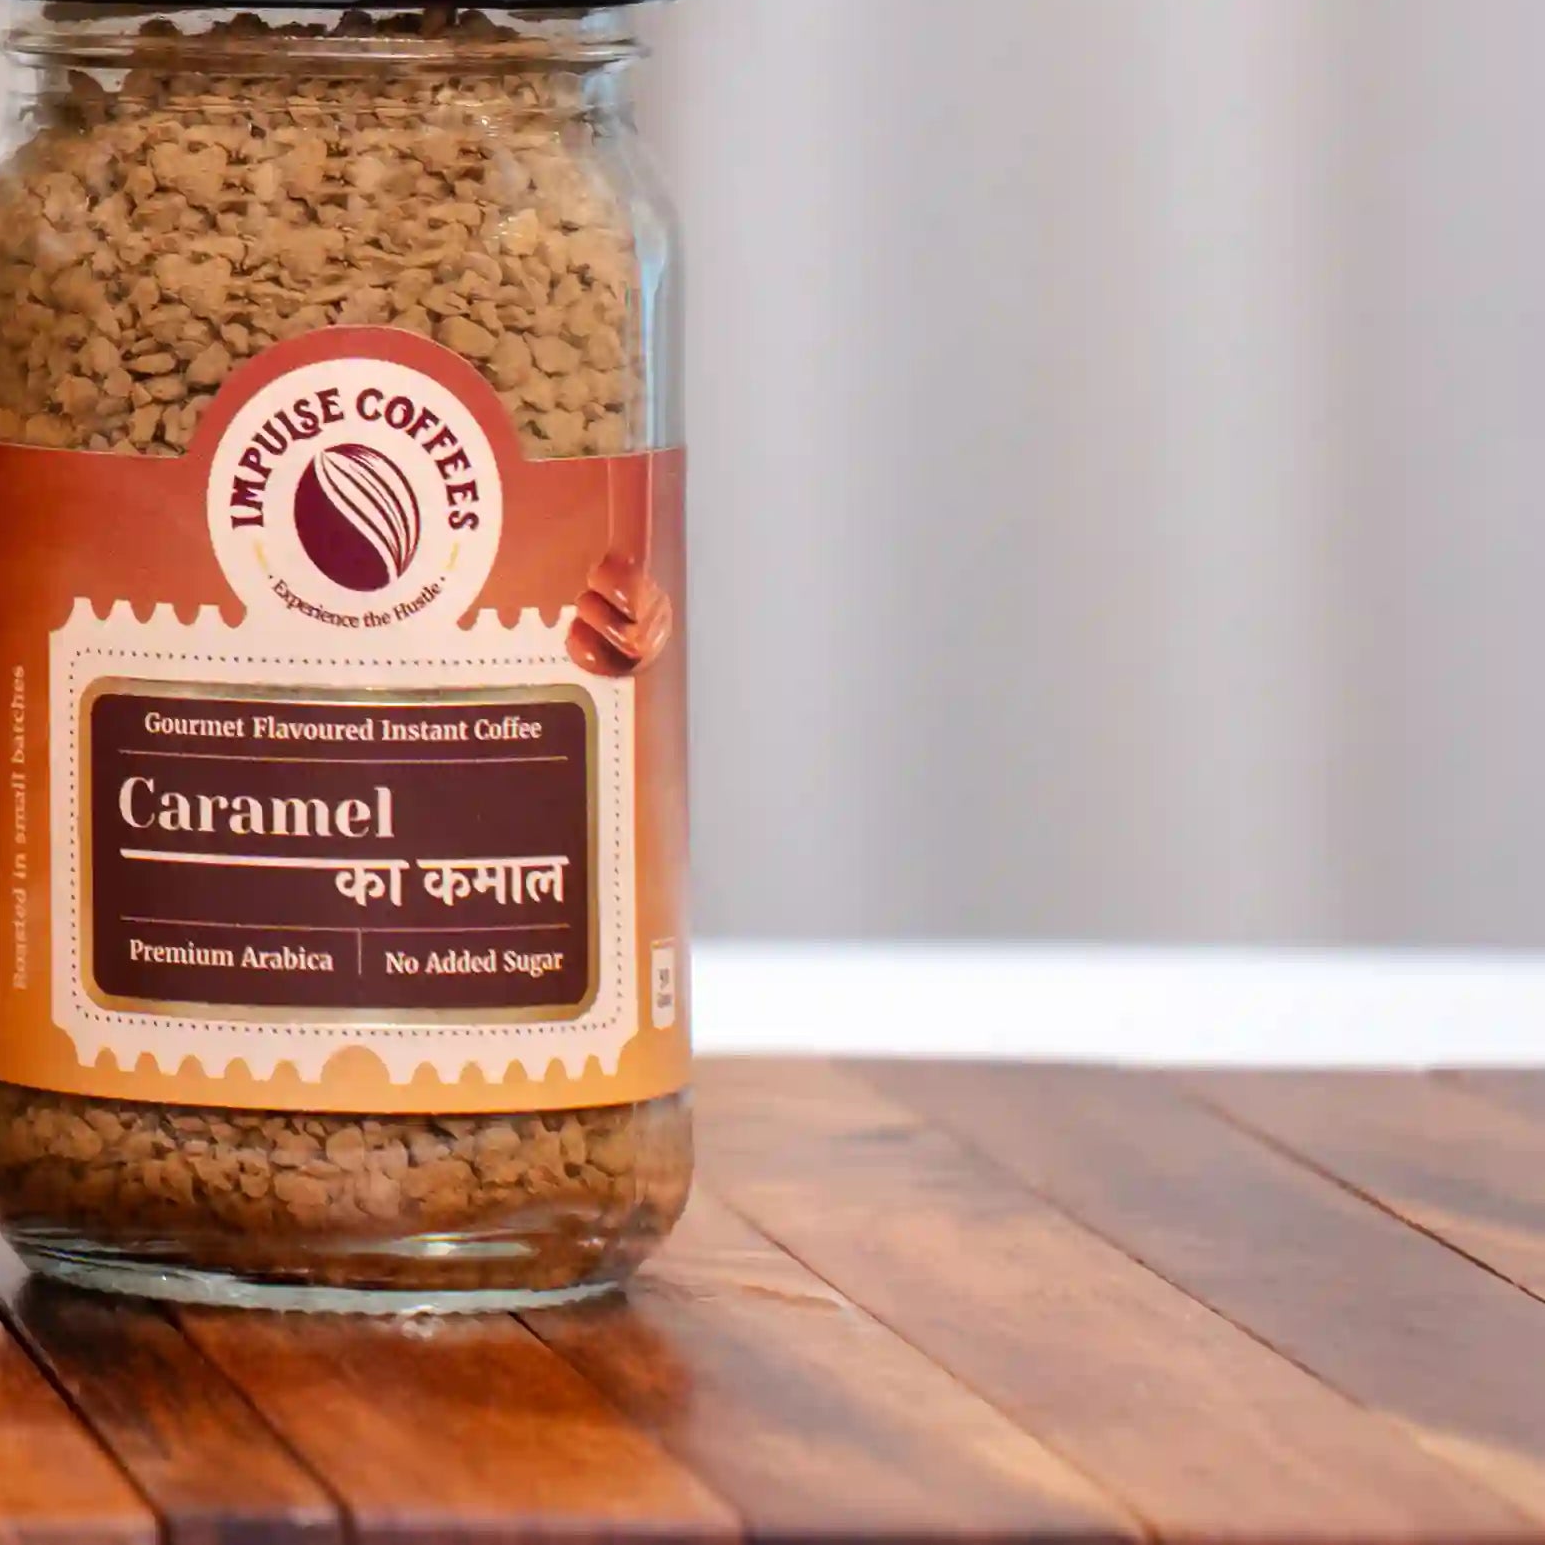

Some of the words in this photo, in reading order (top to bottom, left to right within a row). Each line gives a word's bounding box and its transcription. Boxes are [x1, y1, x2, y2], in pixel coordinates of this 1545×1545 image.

[230, 387, 344, 530] IMPULSE
[355, 386, 480, 532] COFFEES
[273, 578, 359, 629] Experience
[363, 611, 390, 629] the
[392, 580, 443, 625] Hustle
[144, 712, 244, 739] Gourmet
[252, 716, 374, 741] Flavoured
[381, 717, 469, 741] Instant
[473, 717, 543, 741] Coffee
[11, 772, 26, 844] small
[118, 776, 395, 840] Caramel
[13, 853, 27, 879] in
[335, 857, 408, 909] का
[417, 857, 570, 907] कमाल
[129, 939, 235, 969] Premium
[241, 945, 334, 973] Arabica
[385, 951, 420, 974] No
[425, 950, 498, 975] Added
[502, 949, 563, 979] Sugar
